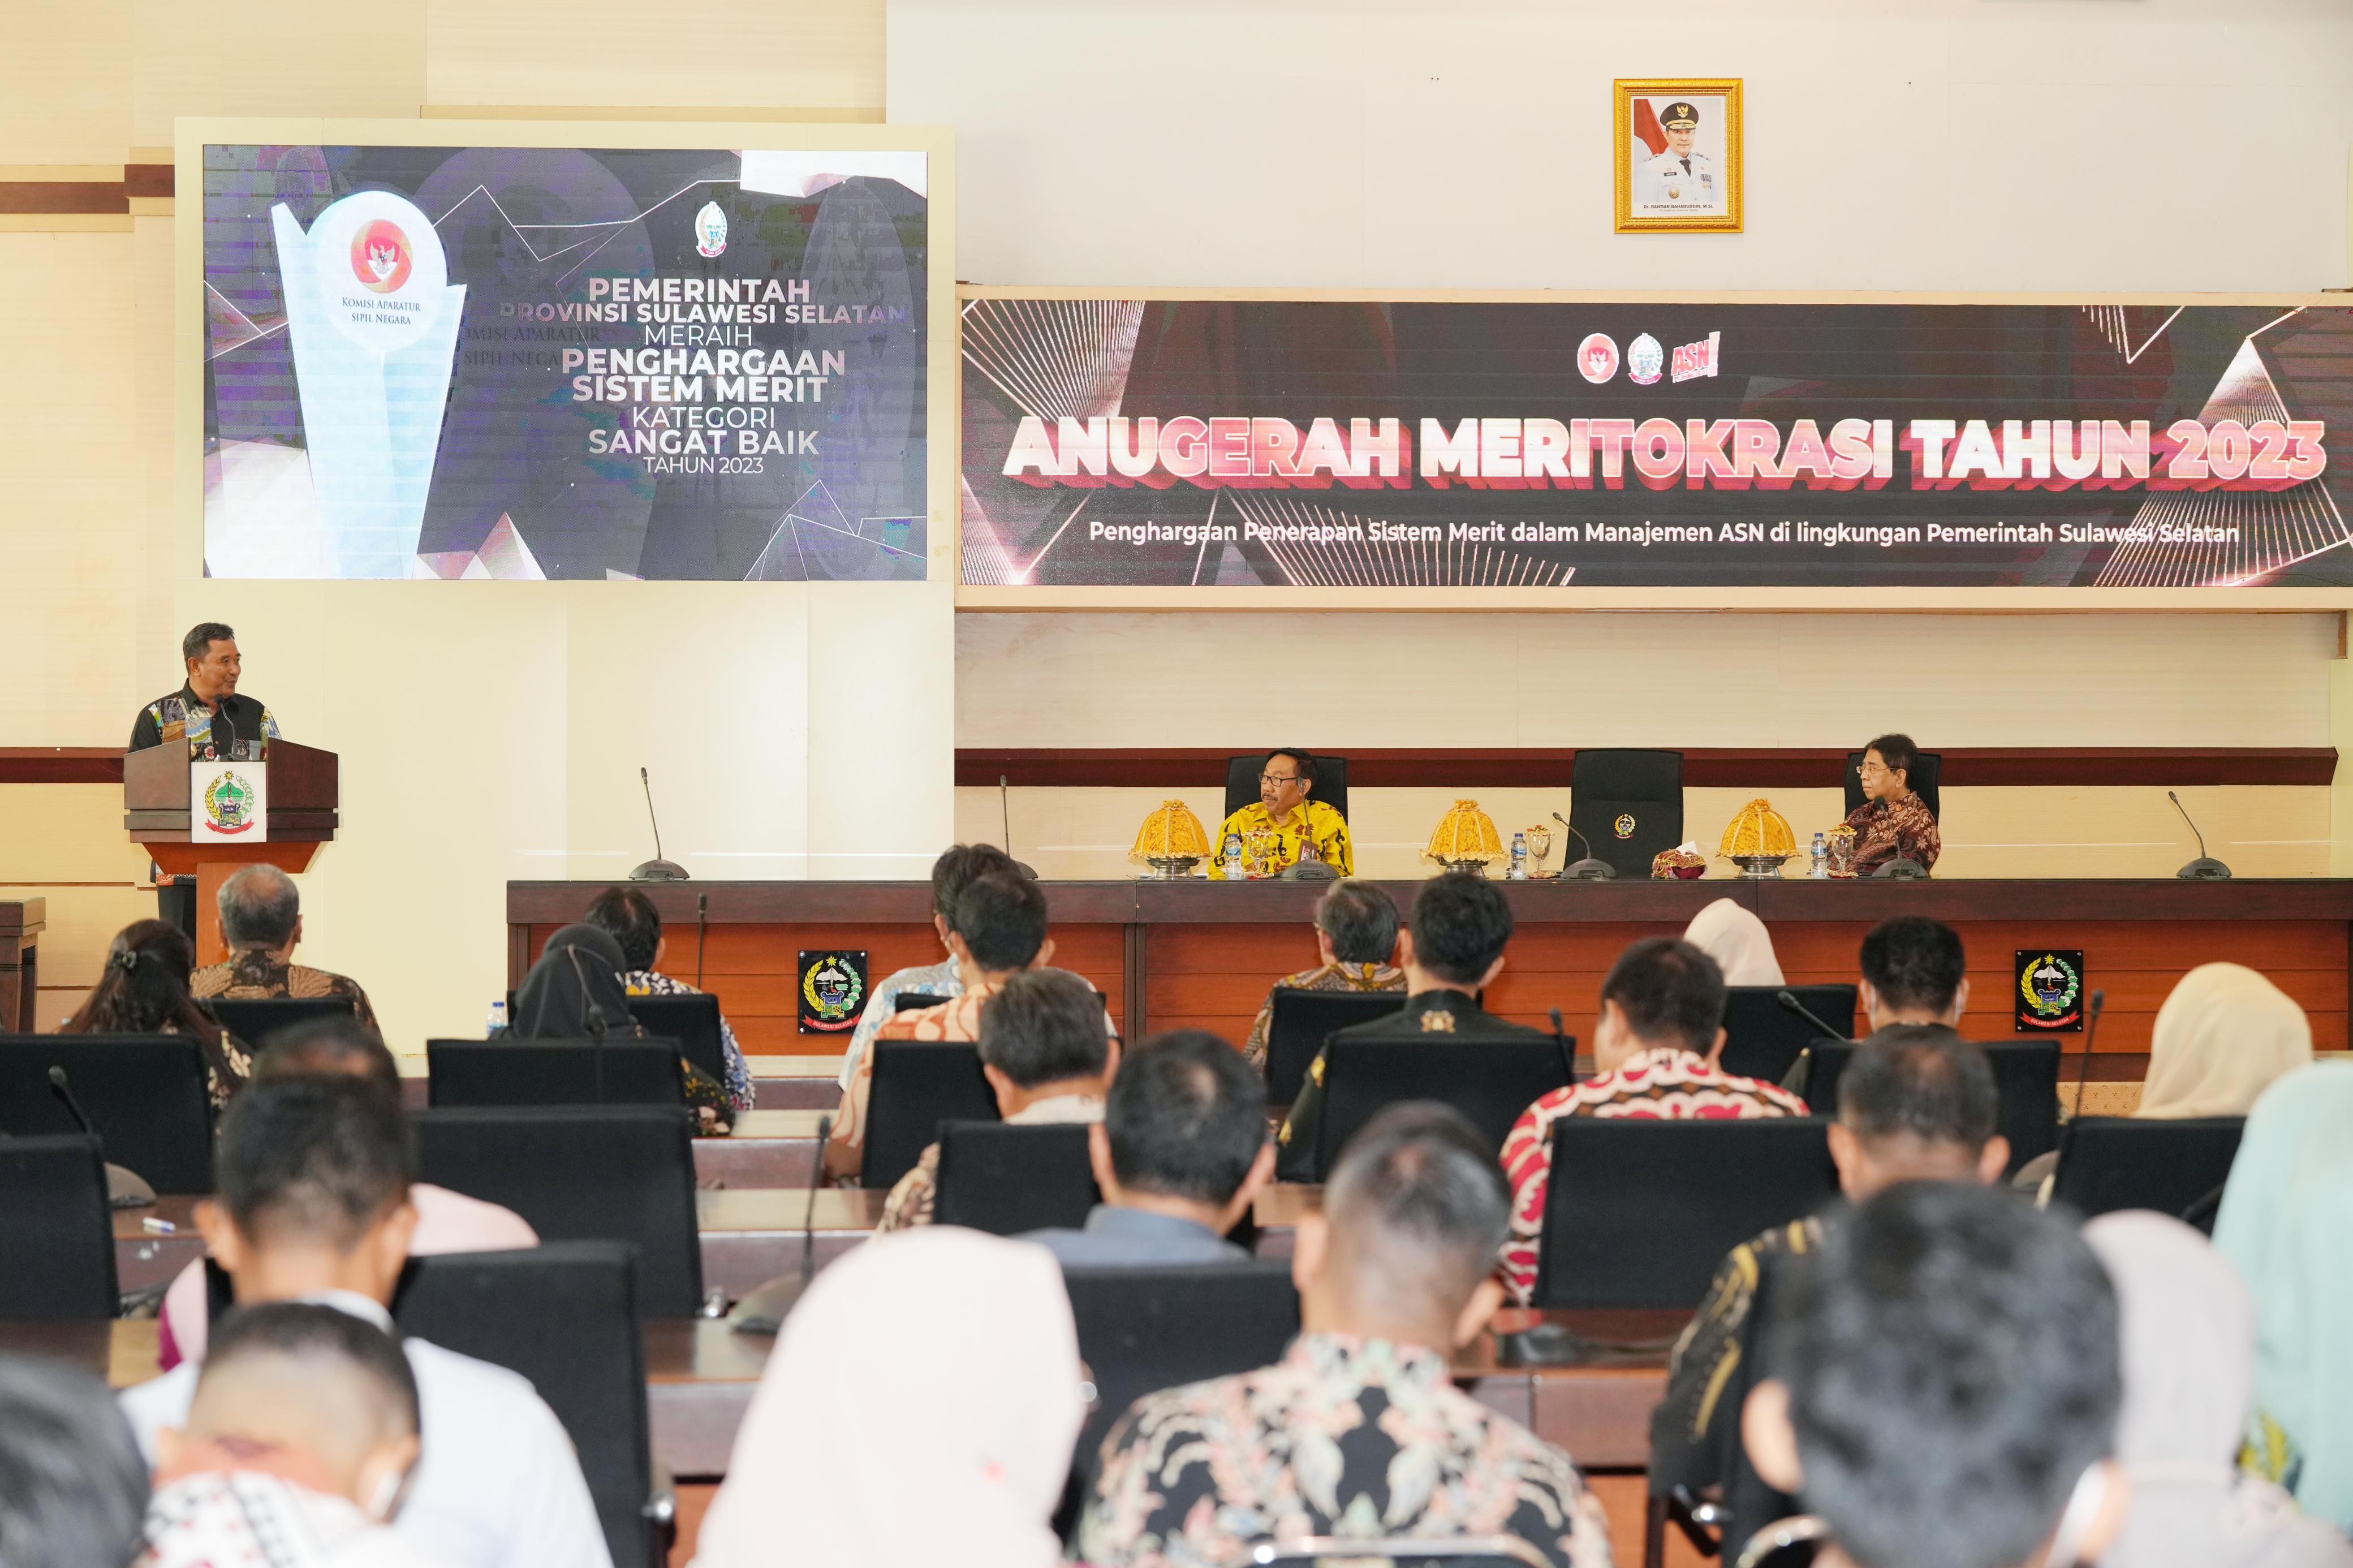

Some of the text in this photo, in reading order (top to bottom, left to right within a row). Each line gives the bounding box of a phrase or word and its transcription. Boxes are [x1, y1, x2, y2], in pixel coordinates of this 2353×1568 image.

[589, 279, 810, 303] PEMERINTAH
[352, 313, 373, 322] SIPIL
[499, 302, 904, 324] PROVINSI SULAWESI SELATAN
[645, 325, 752, 346] MERAIH
[562, 348, 846, 376] PENGHARGAAN
[572, 375, 828, 403] SISTEM MERIT
[632, 407, 775, 428] KATEGORI
[589, 429, 820, 455] SANGAT BAIK
[1002, 416, 2327, 480] ANUGERAH MERITOKRASI TAHUN 2023
[644, 456, 764, 473] TAHUN 2023
[1090, 521, 2239, 547] Penghargaan Penerapan Sistem Merit dalam Manajemen ASN di lingkungan Pemerintah Sulawesi Selatan
[813, 1019, 853, 1029] SULAWESI SELATAN
[2030, 1018, 2070, 1026] SULAWESI SELATAN
